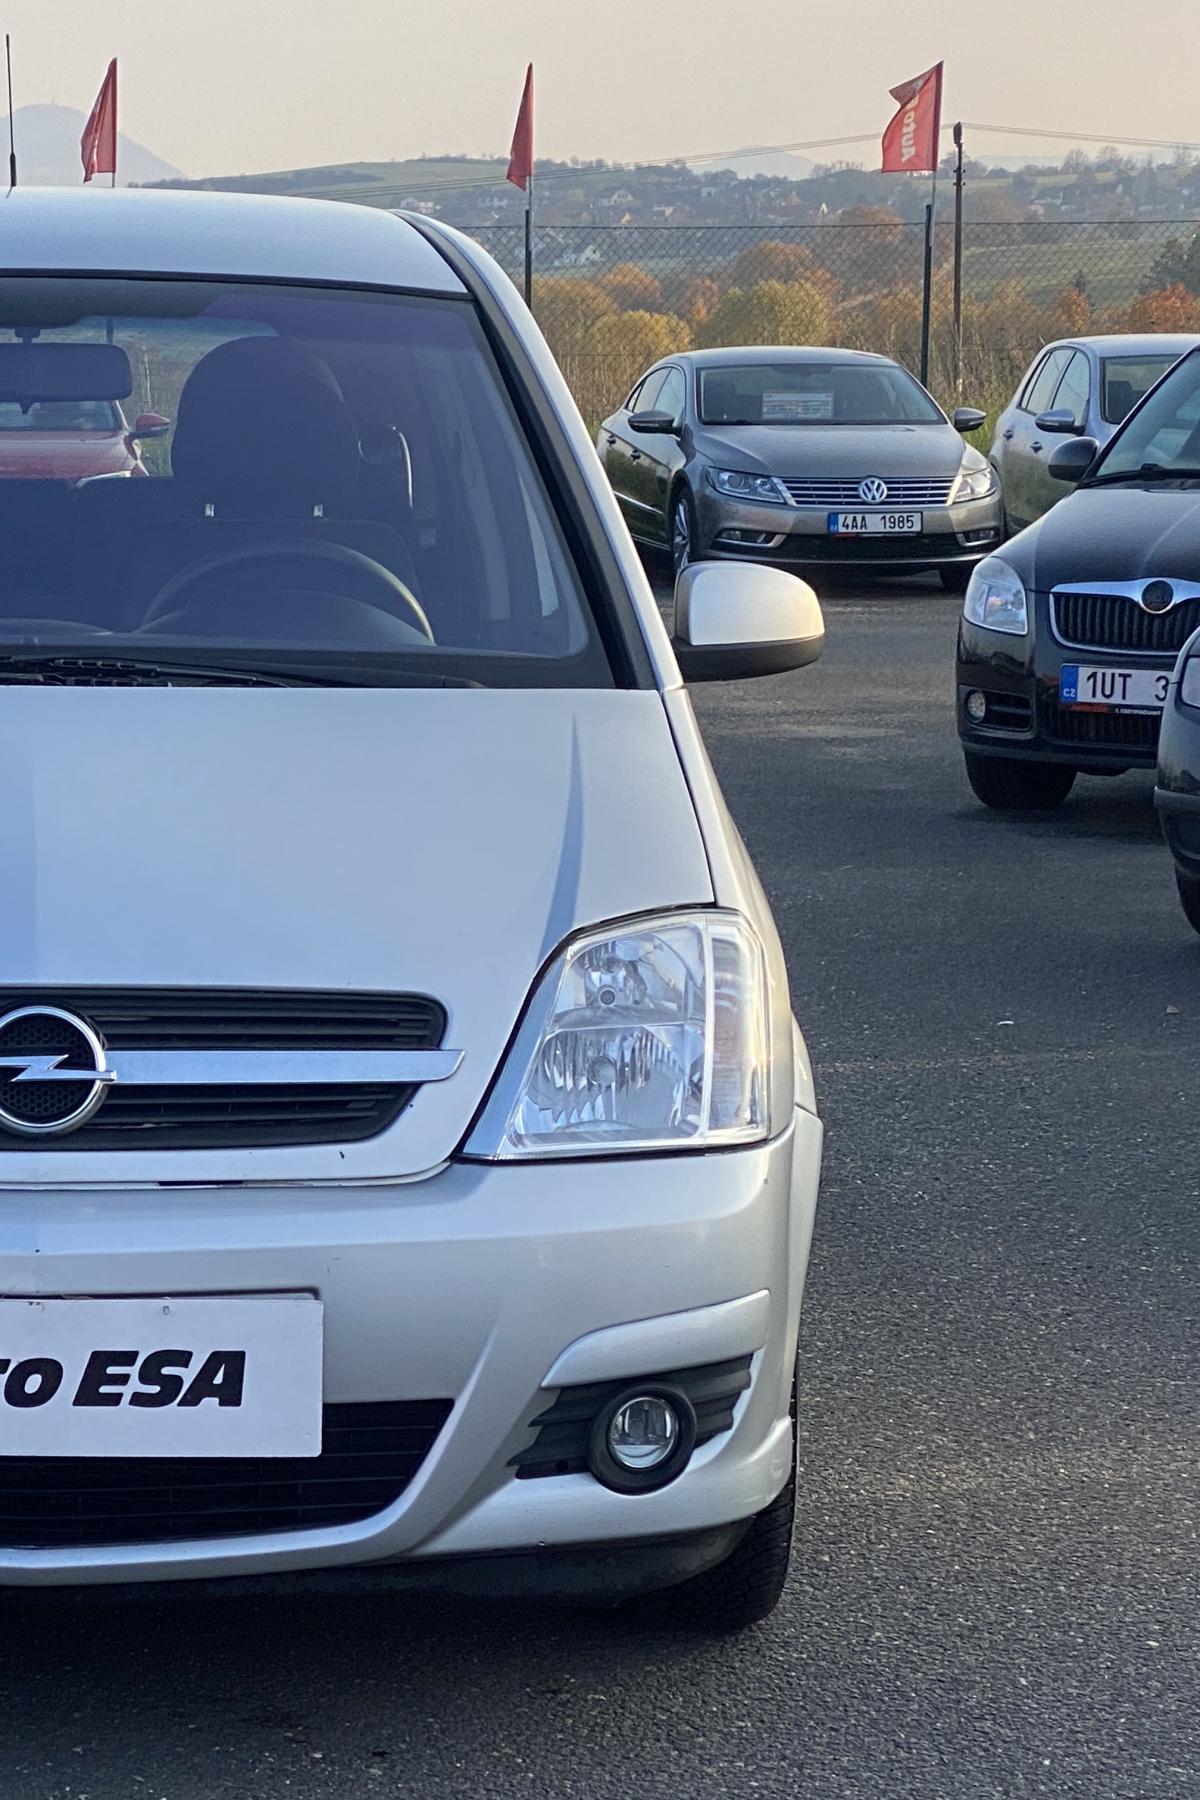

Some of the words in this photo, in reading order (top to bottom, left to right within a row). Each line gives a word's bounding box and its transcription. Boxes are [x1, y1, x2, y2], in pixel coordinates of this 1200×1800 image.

[842, 515, 868, 530] 4AA
[880, 515, 914, 529] 1985
[1063, 688, 1076, 697] CZ
[1087, 671, 1132, 700] 1UT
[71, 1350, 246, 1408] ESA
